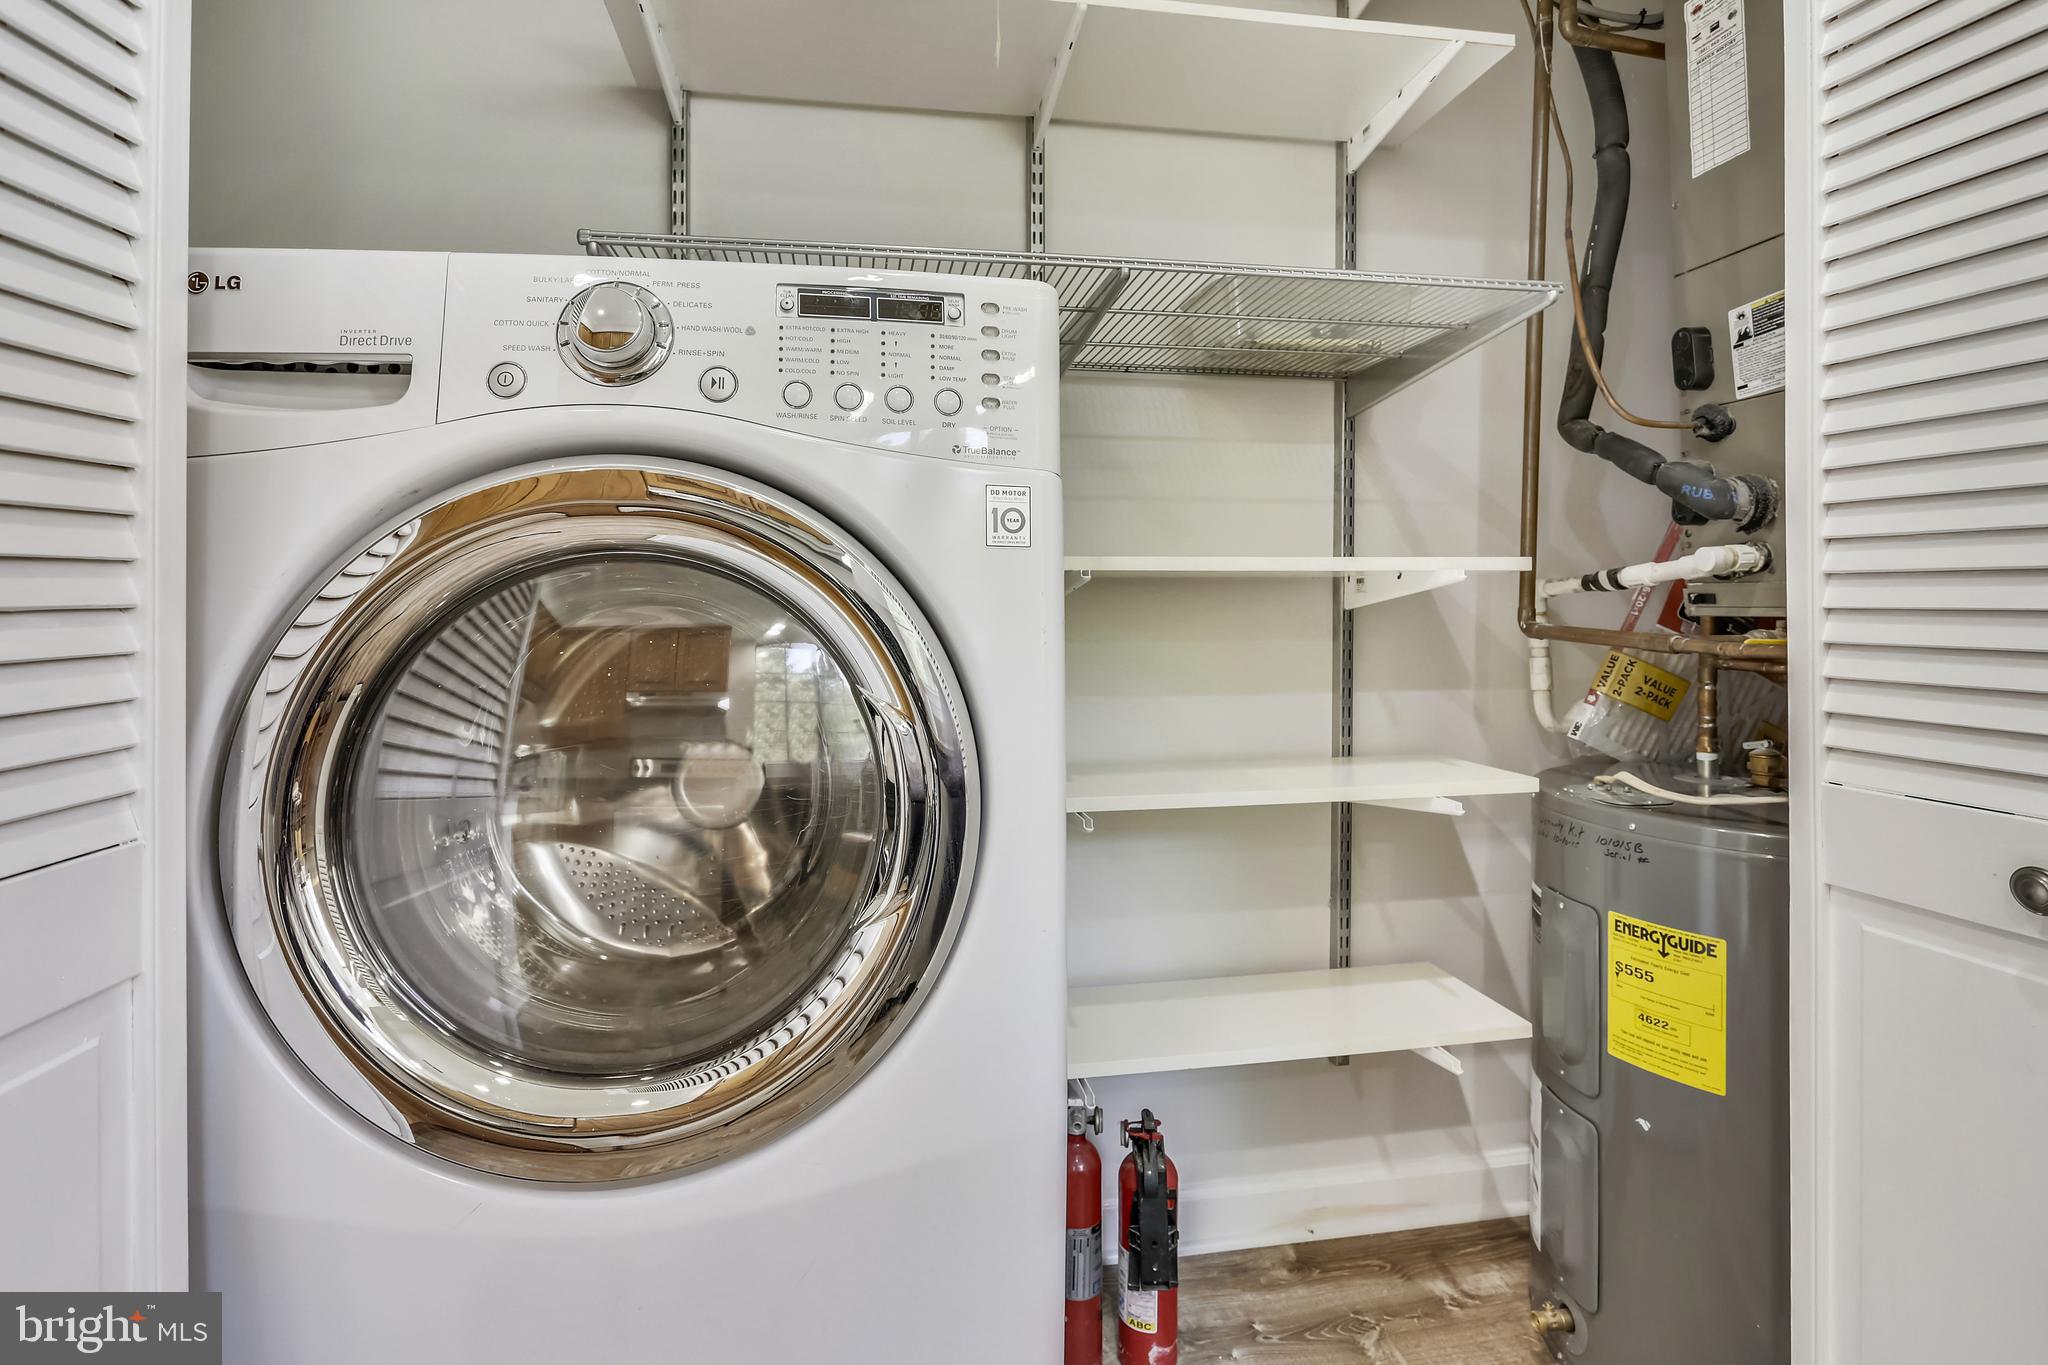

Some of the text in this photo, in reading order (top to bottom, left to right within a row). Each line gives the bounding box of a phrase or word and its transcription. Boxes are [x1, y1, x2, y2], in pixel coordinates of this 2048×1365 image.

[215, 275, 242, 290] LG
[676, 281, 701, 290] PRESS
[526, 295, 564, 304] SANITARY
[672, 301, 713, 310] DELICATES
[493, 319, 550, 328] COTTON QUICK
[681, 324, 701, 333] HAND
[502, 344, 551, 353] SPEED WASH
[938, 354, 962, 362] NORMAL
[775, 411, 818, 421] WASH/RINSE
[829, 414, 845, 423] SPIN
[882, 417, 917, 427] SOIL LEVEL
[941, 421, 956, 429] DRY
[989, 425, 1013, 433] OPTION
[991, 507, 1026, 534] 10
[1597, 653, 1620, 688] VALUE
[1612, 658, 1638, 697] 2-PACK
[1643, 675, 1677, 698] VALUE
[1634, 686, 1673, 710] 2-PACK
[1615, 960, 1655, 983] $555
[1638, 1013, 1670, 1031] 4622
[1128, 1318, 1152, 1331] ABC
